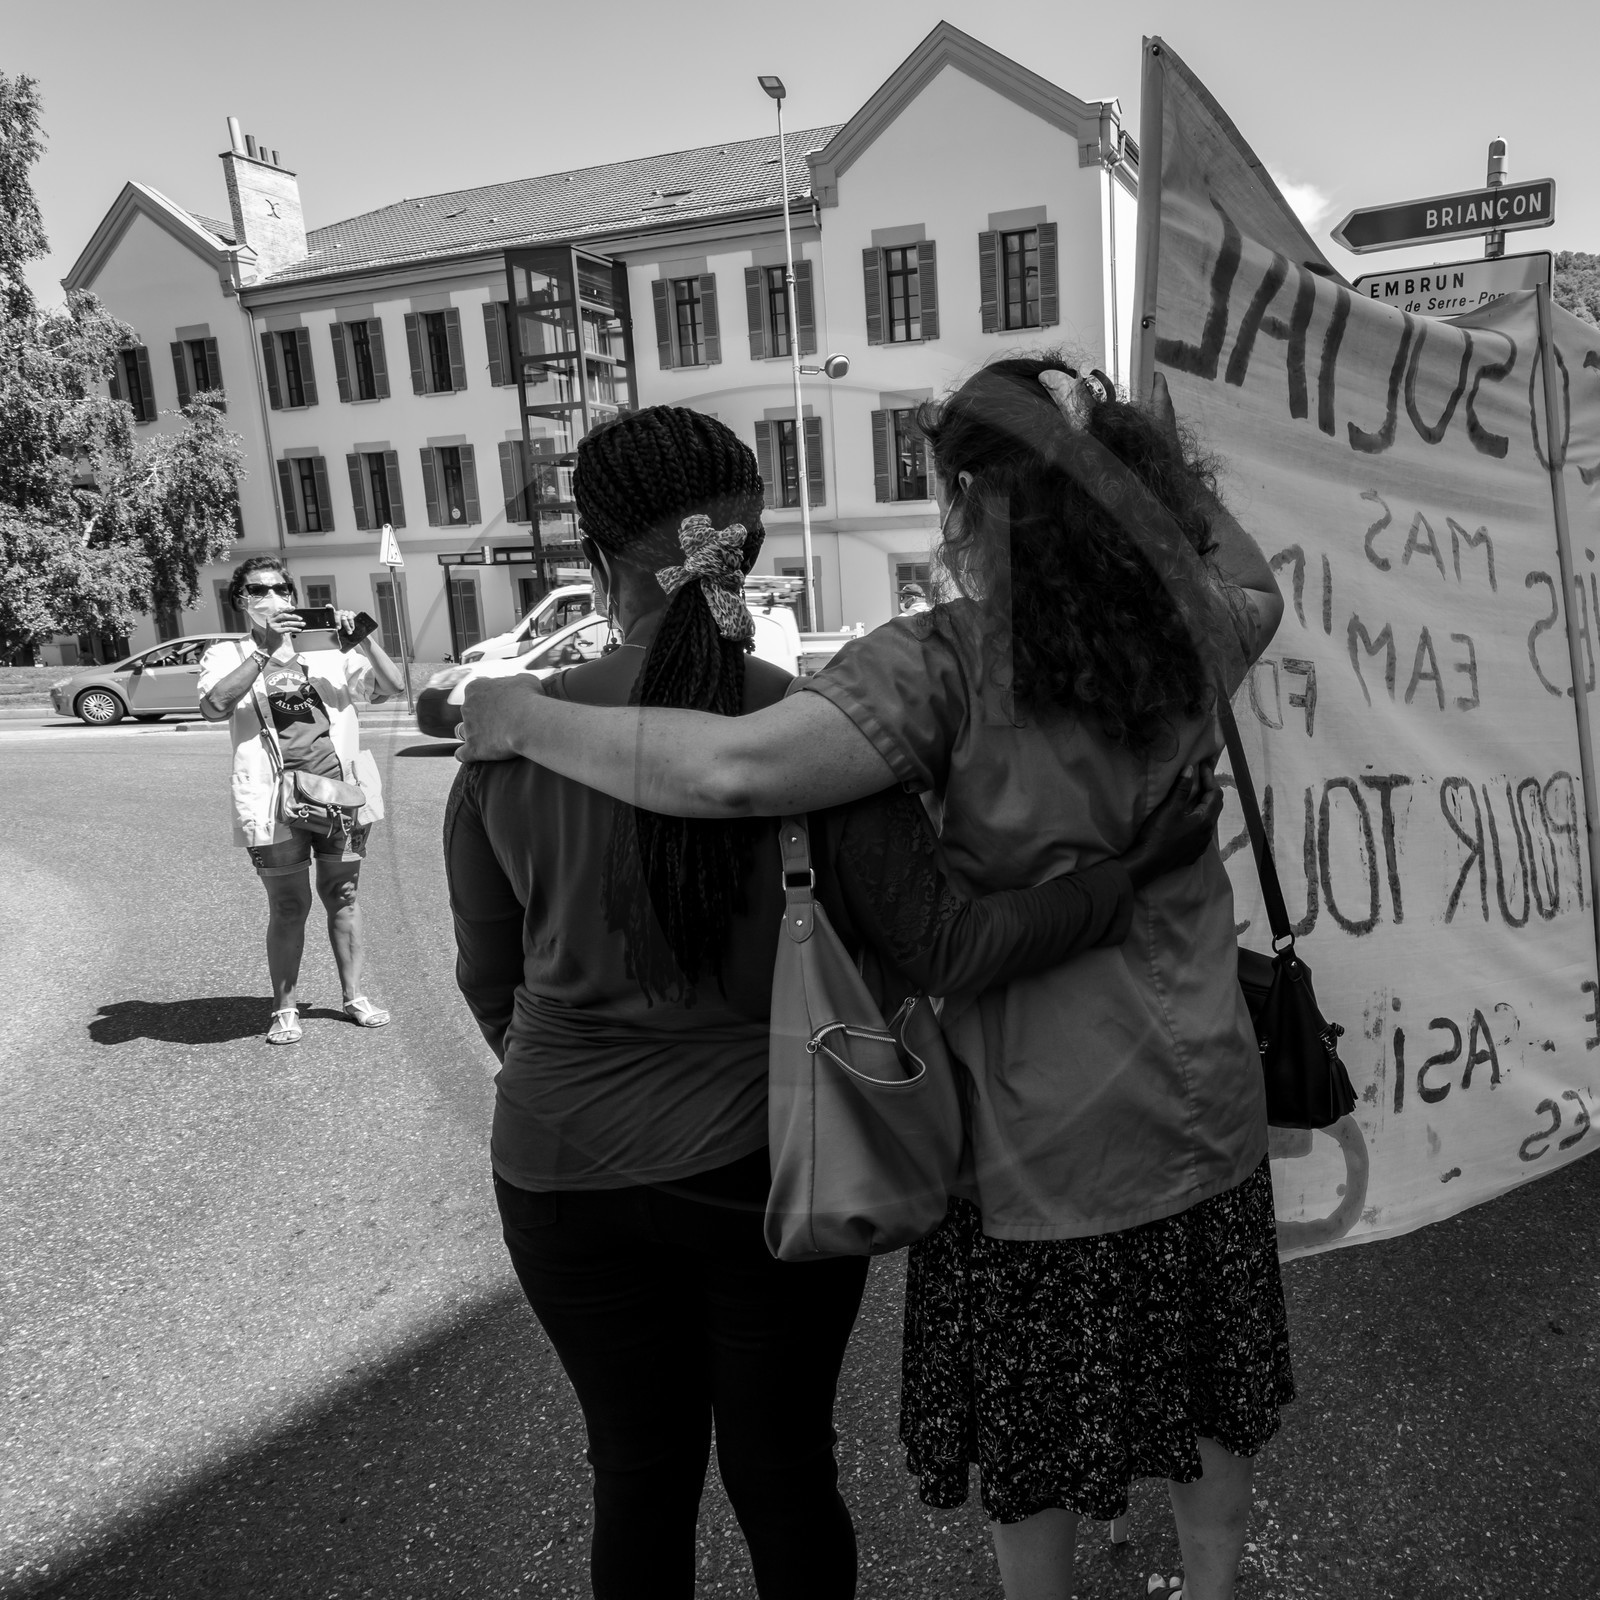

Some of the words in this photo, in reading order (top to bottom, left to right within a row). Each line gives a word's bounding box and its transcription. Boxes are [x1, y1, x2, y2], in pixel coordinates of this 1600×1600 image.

[1426, 192, 1542, 229] BRIANÇON
[1370, 272, 1464, 298] EMBRUN
[1405, 300, 1421, 313] de
[1427, 291, 1505, 310] Serre-Po
[275, 699, 292, 711] ALL
[293, 697, 314, 711] STAR
